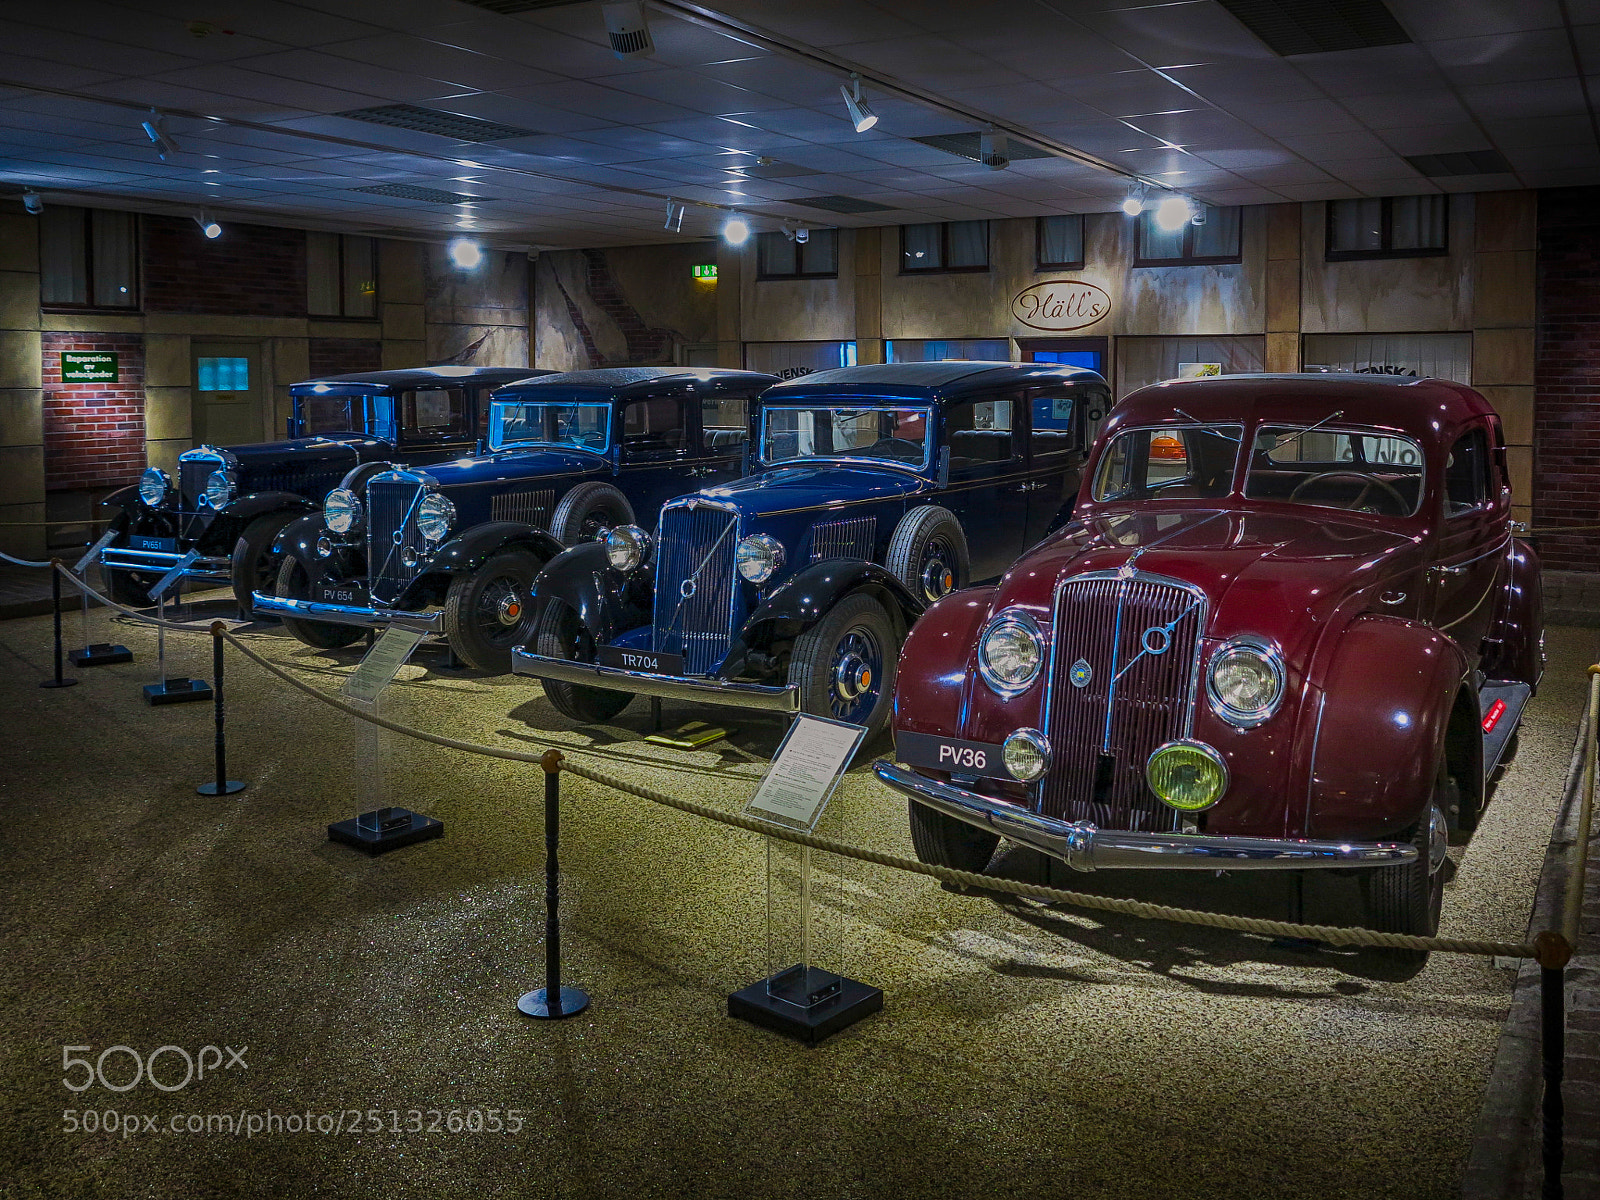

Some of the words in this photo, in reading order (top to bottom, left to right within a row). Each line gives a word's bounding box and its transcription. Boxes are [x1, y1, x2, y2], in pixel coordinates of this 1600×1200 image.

[1019, 291, 1105, 319] Häll's
[65, 354, 112, 364] Reparation
[65, 370, 115, 380] velocipeder
[772, 366, 814, 380] VENSK
[323, 589, 336, 600] PV
[337, 590, 353, 602] 654
[621, 653, 659, 670] TR704
[938, 744, 987, 770] PV36
